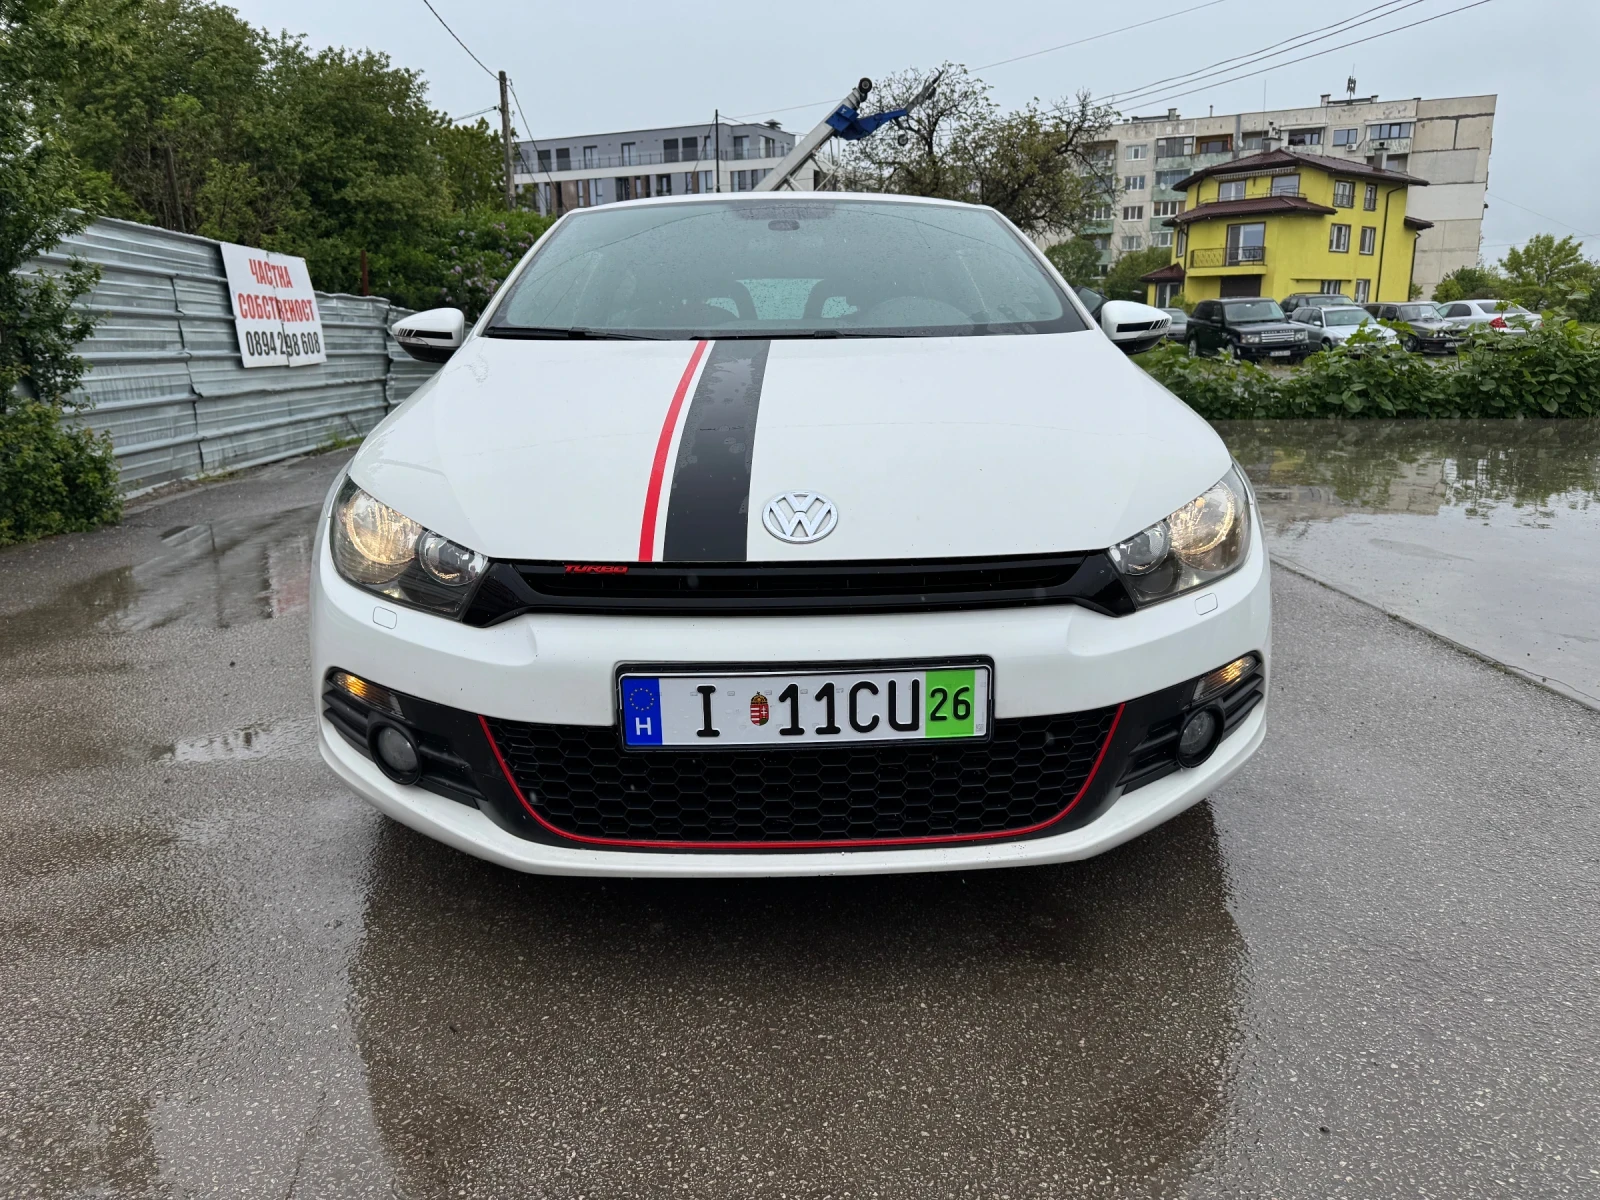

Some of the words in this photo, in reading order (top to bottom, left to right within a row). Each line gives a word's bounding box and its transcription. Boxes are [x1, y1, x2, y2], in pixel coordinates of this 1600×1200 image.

[249, 259, 293, 288] ЧАСТНА
[238, 293, 315, 322] СОБСТВЕНОСТ
[245, 330, 278, 357] 0894
[277, 331, 301, 357] 298
[300, 331, 321, 355] 608
[564, 564, 629, 574] TURBO
[778, 678, 920, 736] 11CU
[929, 686, 971, 721] 26
[635, 717, 652, 736] H
